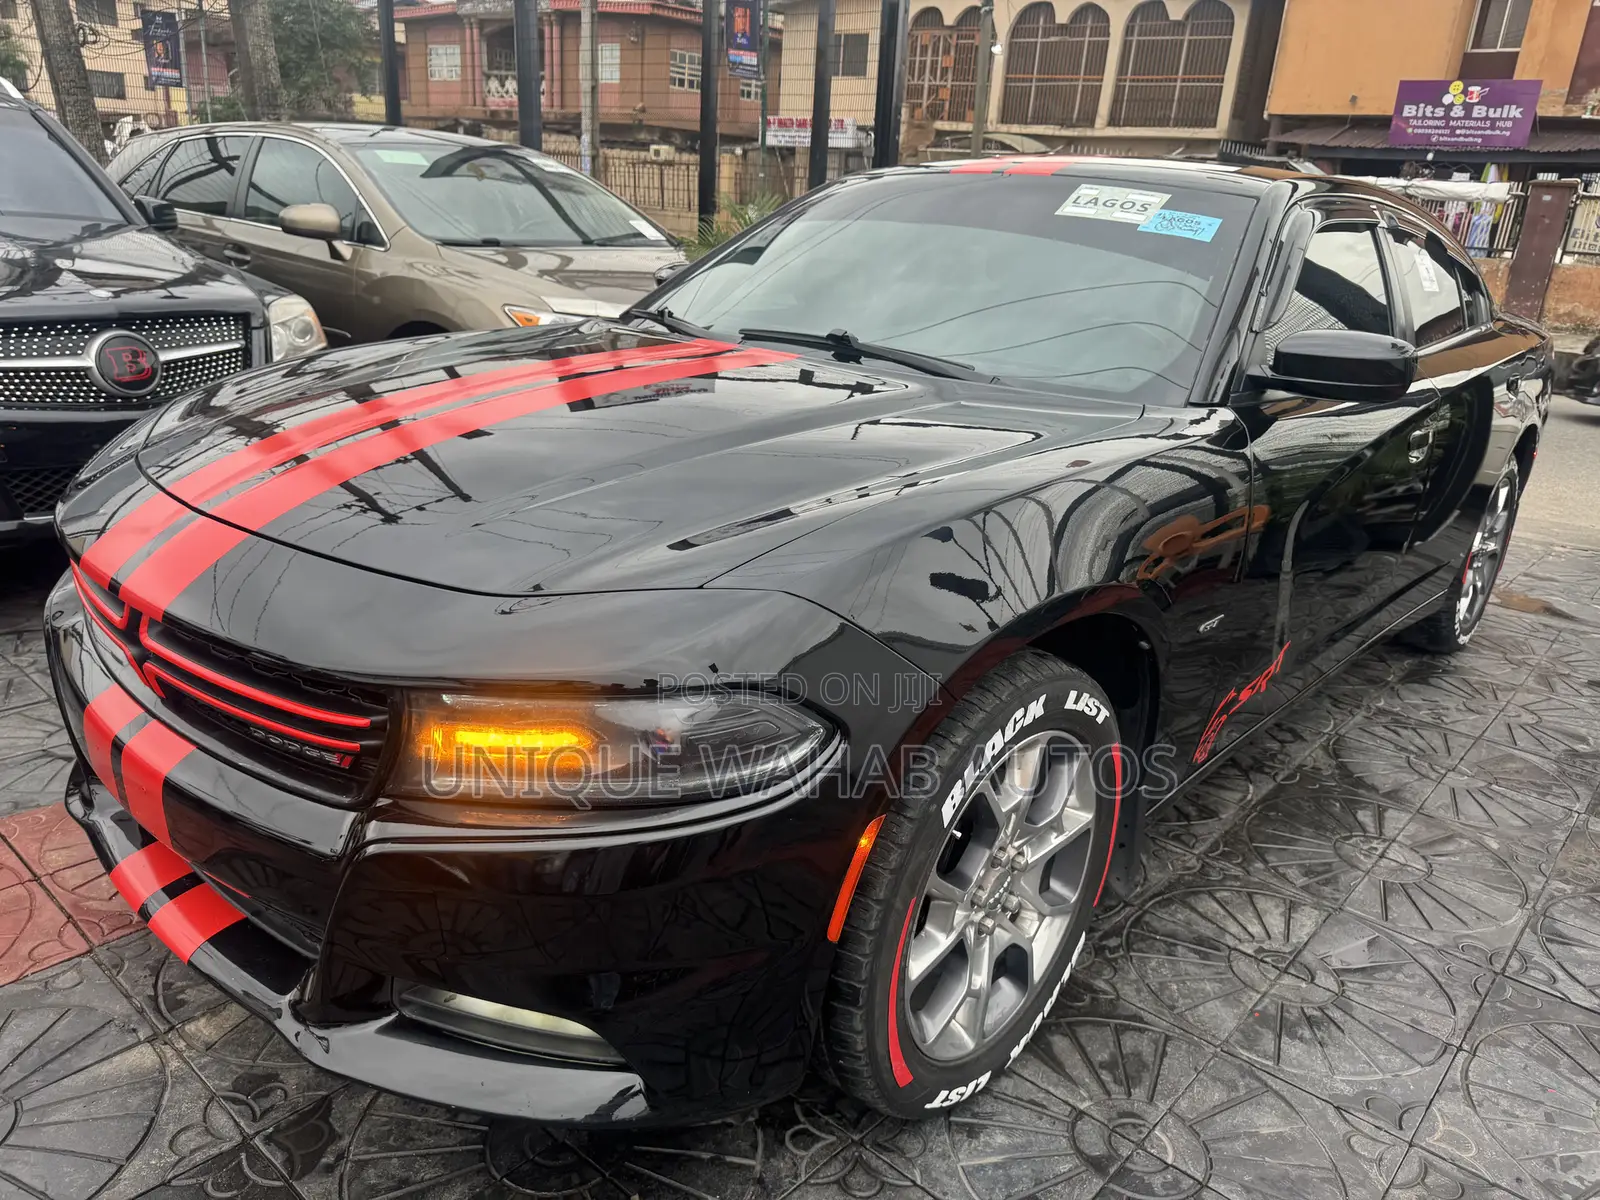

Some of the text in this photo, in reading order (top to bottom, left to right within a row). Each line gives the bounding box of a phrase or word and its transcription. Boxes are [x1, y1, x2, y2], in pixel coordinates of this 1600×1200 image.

[1402, 103, 1524, 118] Bits & Bulk
[1409, 119, 1446, 127] TAILORING
[1072, 195, 1151, 213] LAGOS
[250, 726, 341, 764] DODGE
[941, 690, 1110, 828] BLACK LIST
[924, 1069, 992, 1109] LIST
